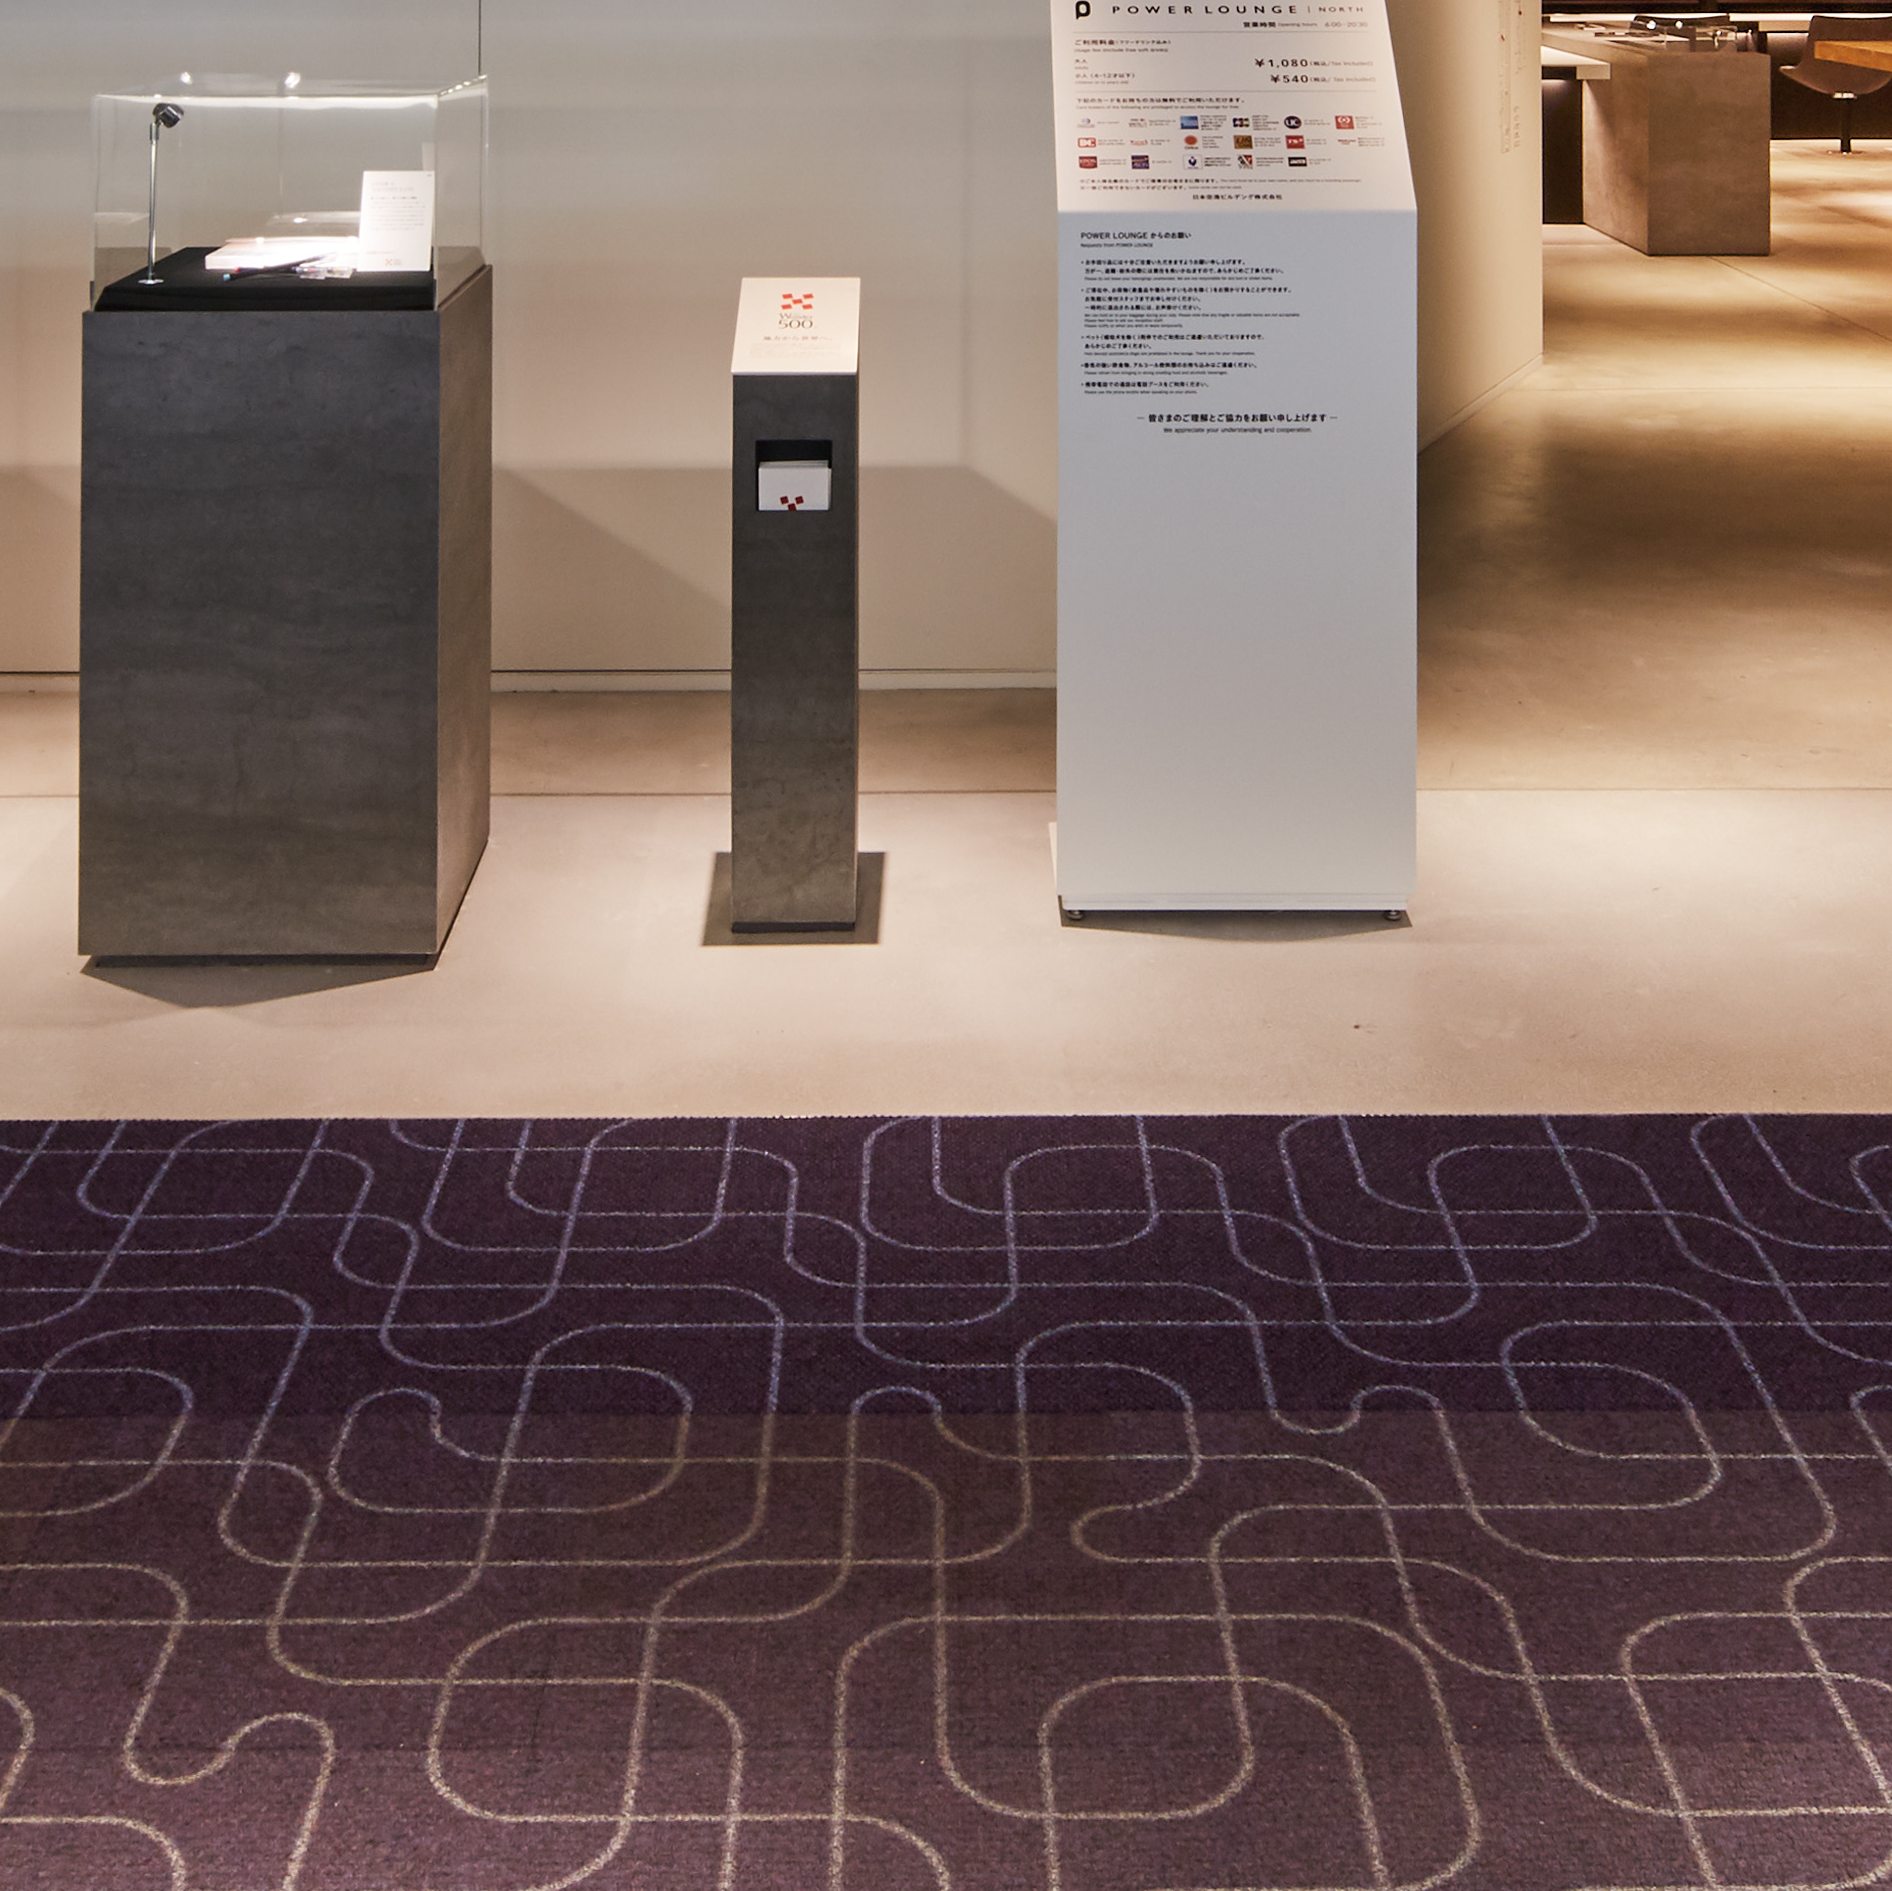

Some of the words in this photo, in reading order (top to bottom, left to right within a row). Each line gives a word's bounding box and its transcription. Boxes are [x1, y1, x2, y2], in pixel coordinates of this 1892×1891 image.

[1112, 5, 1193, 14] POWER
[1204, 5, 1297, 14] LOUNGE
[1081, 231, 1110, 239] POWER
[1113, 231, 1148, 239] LOUNGE
[1150, 231, 1191, 239] からのお願い
[778, 319, 814, 330] 500
